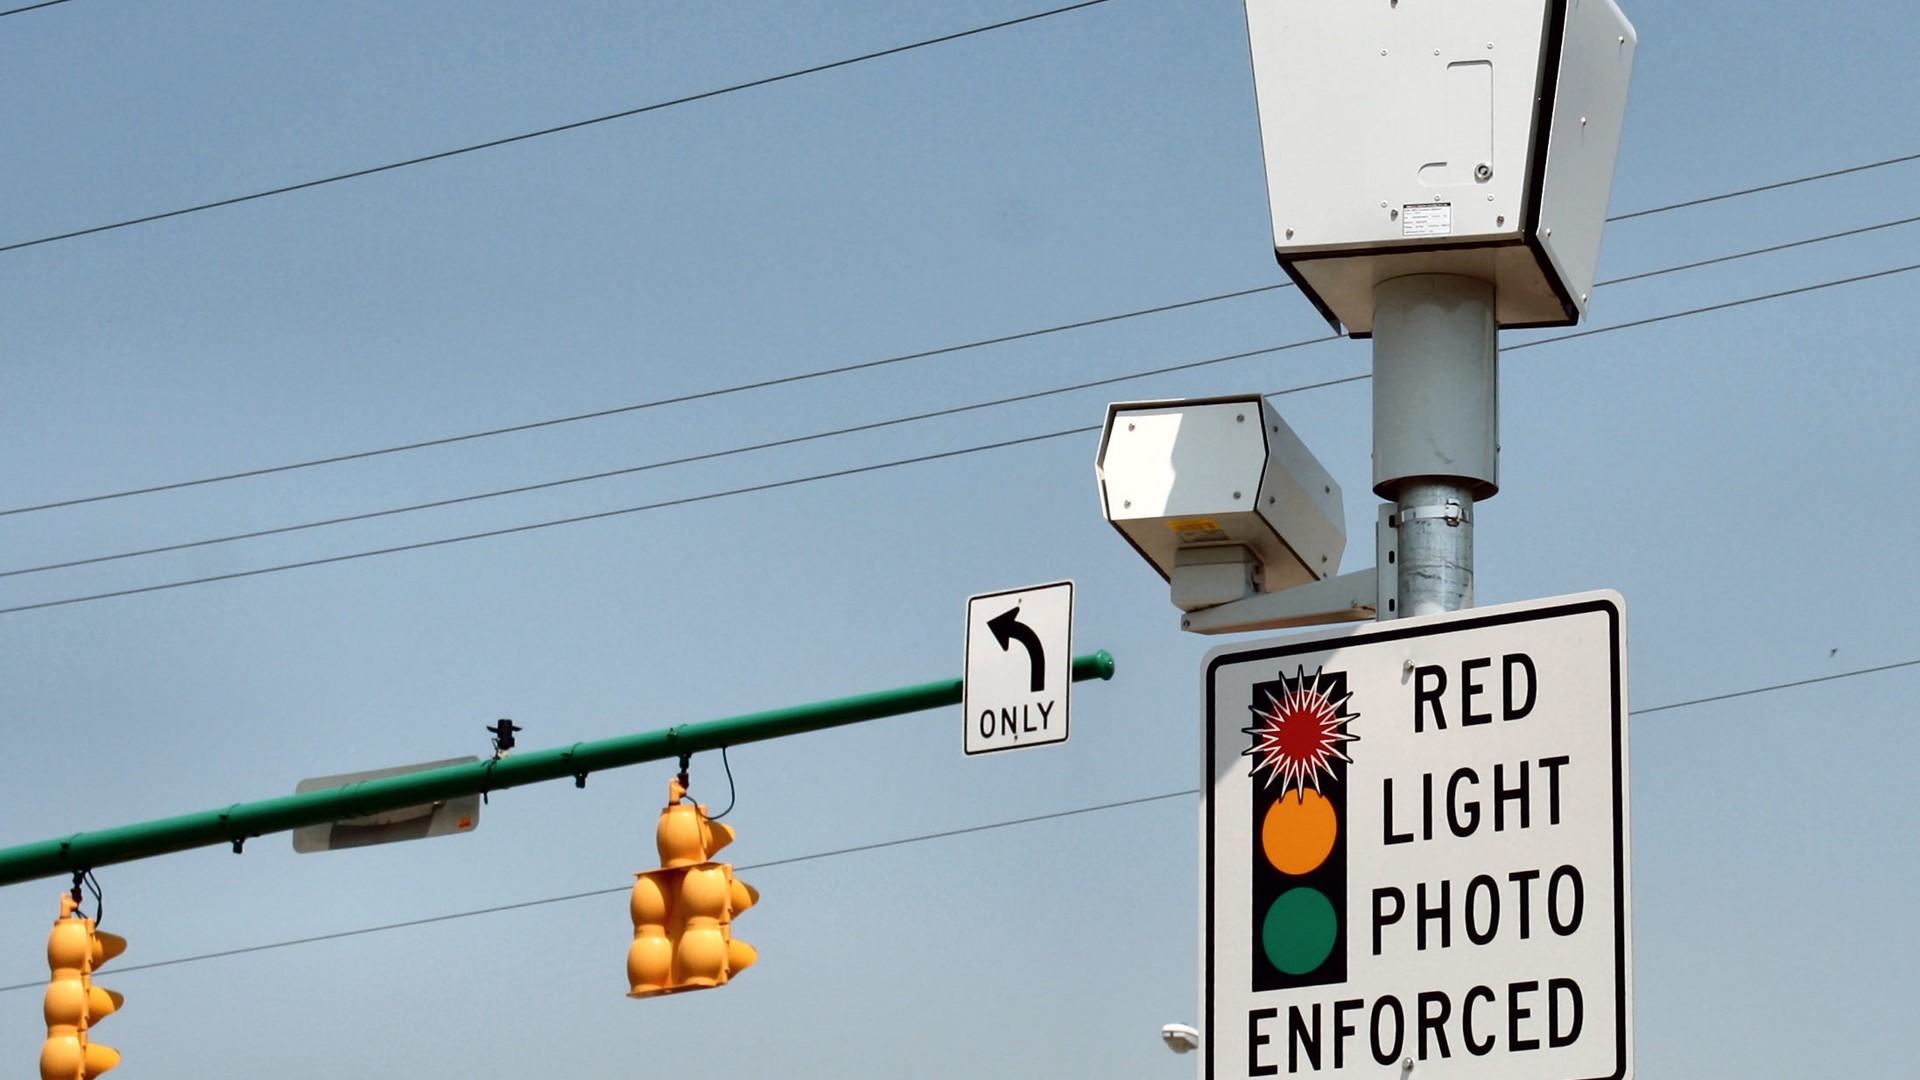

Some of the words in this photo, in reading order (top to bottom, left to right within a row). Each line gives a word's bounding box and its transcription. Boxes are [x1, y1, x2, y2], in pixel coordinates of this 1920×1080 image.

[979, 700, 1055, 739] ONLY
[1414, 652, 1537, 733] RED
[1383, 755, 1570, 846] LIGHT
[1372, 864, 1584, 956] PHOTO
[1248, 977, 1584, 1078] ENFORCED
